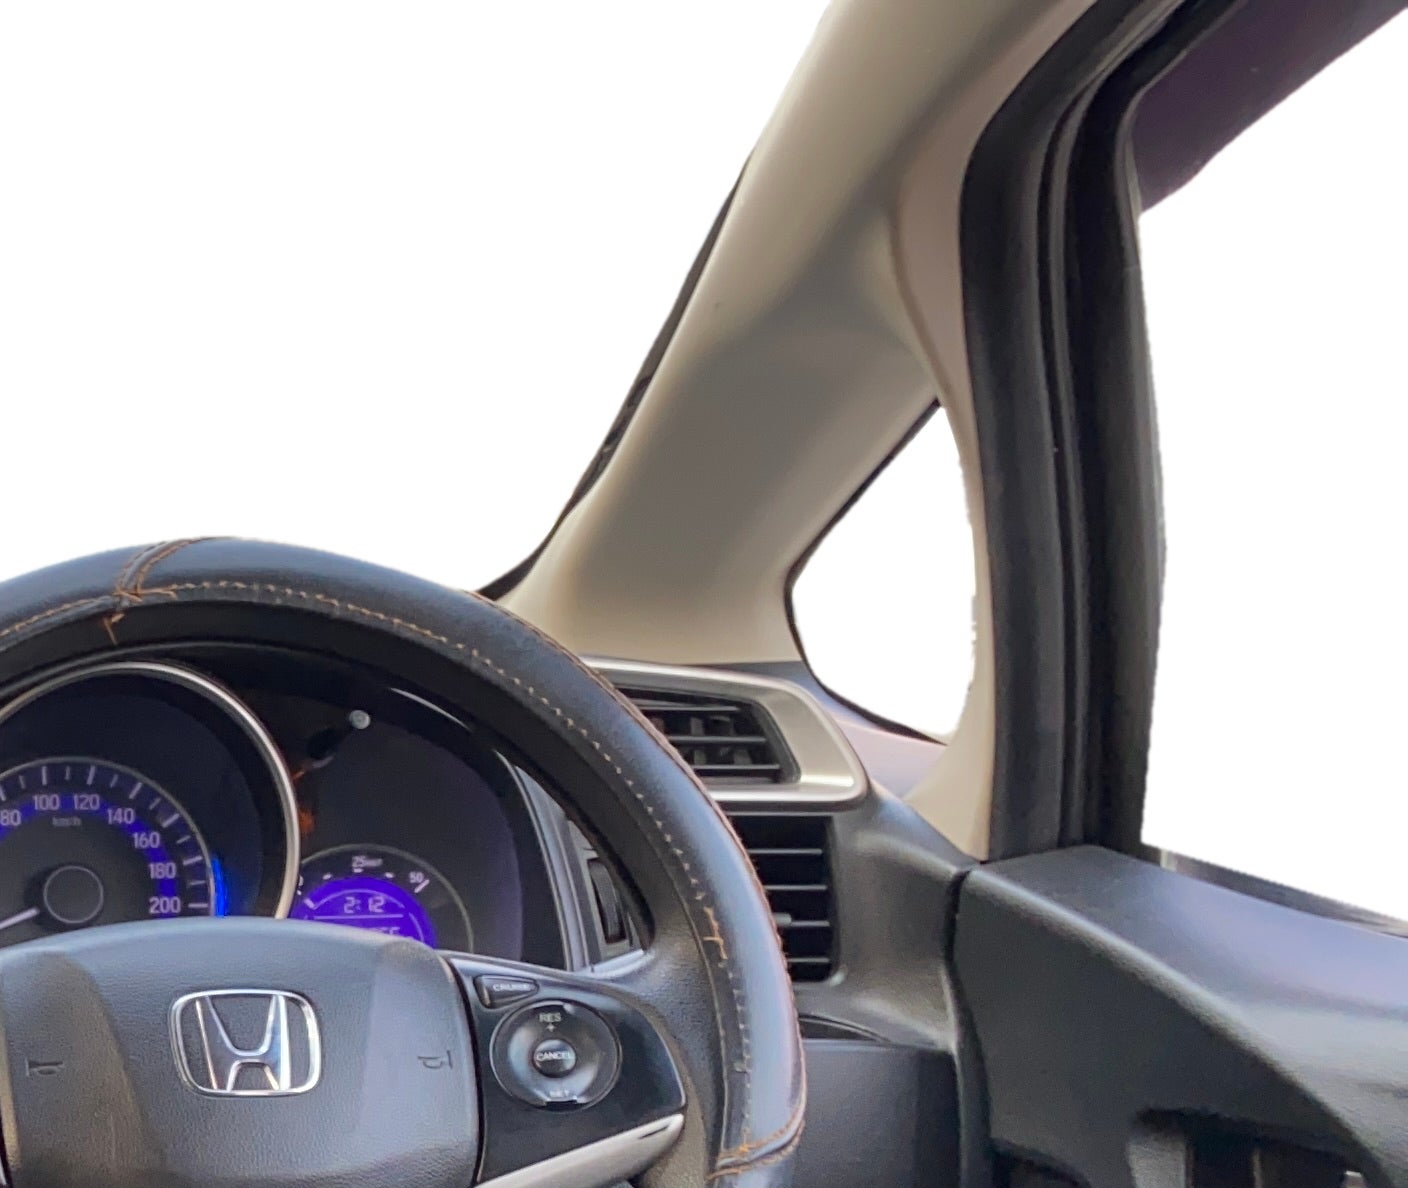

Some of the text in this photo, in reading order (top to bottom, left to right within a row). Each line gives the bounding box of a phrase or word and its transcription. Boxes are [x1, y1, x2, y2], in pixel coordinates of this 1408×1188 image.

[34, 794, 60, 811] 100
[74, 793, 101, 811] 120
[0, 809, 21, 826] 80
[108, 807, 135, 825] 140
[134, 831, 161, 849] 160
[150, 862, 177, 880] 180
[409, 871, 424, 884] 50
[150, 896, 182, 915] 200
[539, 1012, 562, 1022] RES
[536, 1051, 572, 1062] CANCEL
